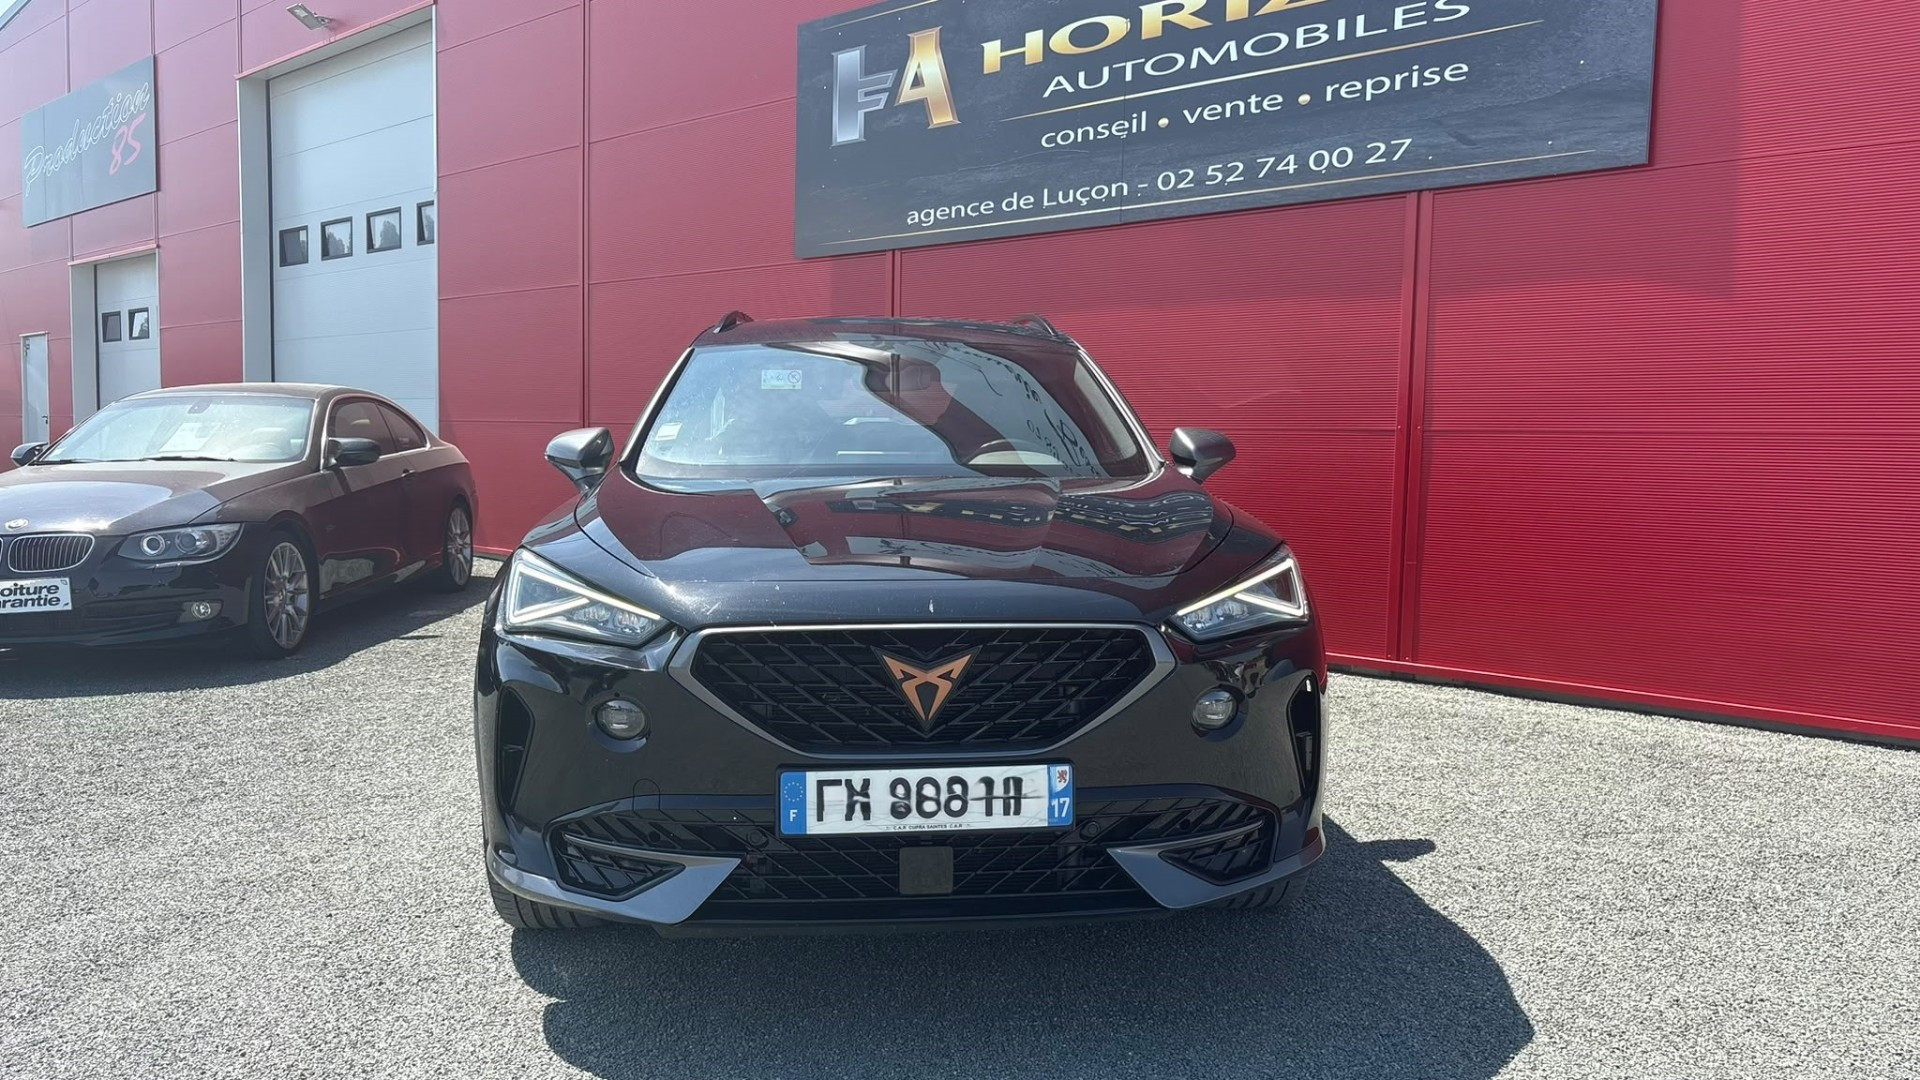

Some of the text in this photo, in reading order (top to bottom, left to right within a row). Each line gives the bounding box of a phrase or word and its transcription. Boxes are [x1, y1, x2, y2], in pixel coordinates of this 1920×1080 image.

[1042, 0, 1471, 98] AUTOMOBILES
[24, 82, 150, 197] Production
[1041, 62, 1469, 148] conseil vente reprise
[109, 113, 146, 176] 85
[907, 200, 994, 227] agence
[1001, 192, 1034, 212] de
[1042, 181, 1128, 206] Luçon
[1157, 168, 1195, 192] 02
[1205, 161, 1245, 185] 52
[1256, 154, 1298, 178] 74
[1308, 146, 1354, 171] 00
[1364, 138, 1413, 164] 27
[0, 594, 61, 609] rantie
[790, 809, 798, 822] F
[1051, 797, 1070, 818] 17
